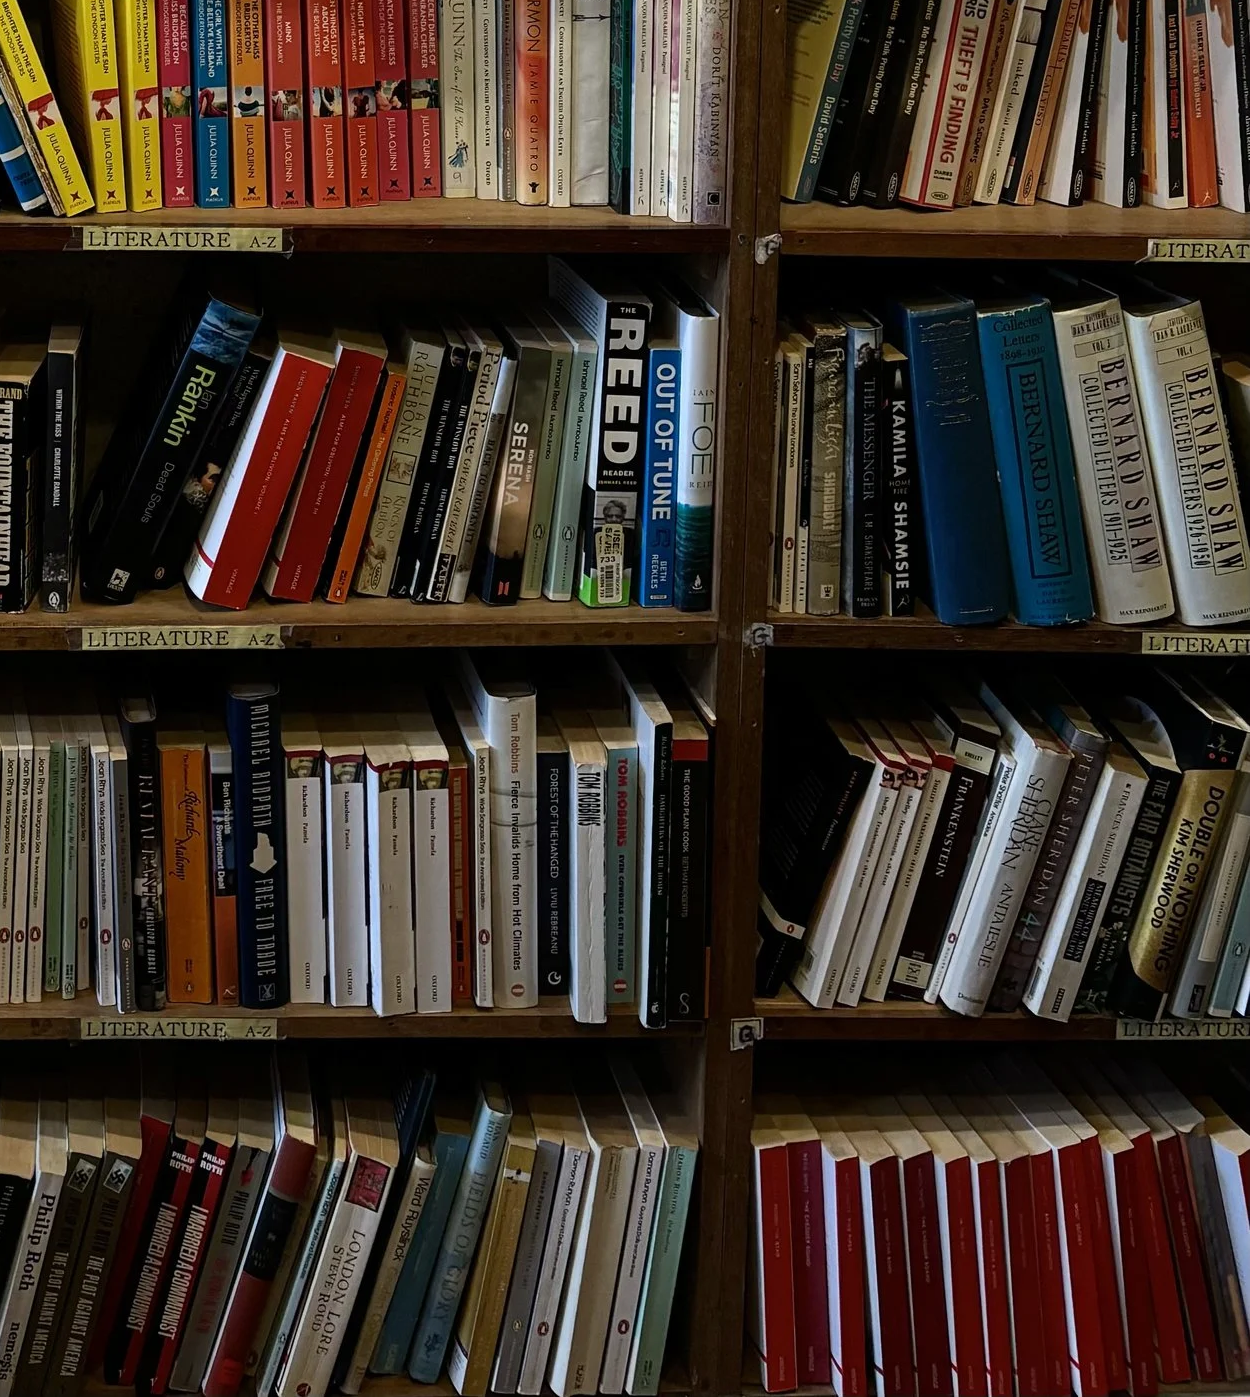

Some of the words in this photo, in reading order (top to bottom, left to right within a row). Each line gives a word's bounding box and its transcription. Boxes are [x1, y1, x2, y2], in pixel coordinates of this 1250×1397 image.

[956, 24, 979, 81] THEFT
[528, 63, 540, 107] JAMIE
[102, 127, 112, 151] JULIA
[529, 116, 541, 173] QUATRO
[939, 96, 967, 165] FINDING
[102, 153, 113, 183] QUINN
[89, 230, 232, 248] LITERATURE
[250, 236, 277, 248] A-Z
[2, 387, 24, 400] RAND
[603, 318, 646, 467] REED
[655, 363, 676, 398] OUT
[654, 420, 674, 443] OF
[891, 400, 907, 479] KAMILA
[503, 421, 529, 507] SERENA
[1098, 357, 1144, 486] BERNARD
[1124, 494, 1161, 568] SHAW
[651, 456, 673, 522] TUNE
[893, 501, 910, 590] SHAMSIE
[88, 630, 230, 646] LITERATURE
[248, 633, 275, 646] A-Z
[250, 704, 270, 765] MICHAEL
[510, 712, 521, 732] Tom
[510, 735, 521, 775] Robbins
[252, 767, 271, 828] RIDPATH
[86, 1022, 227, 1038] LITERATURE
[245, 1025, 271, 1038] A-Z
[27, 1193, 56, 1249] Philip
[18, 1251, 43, 1292] Roth
